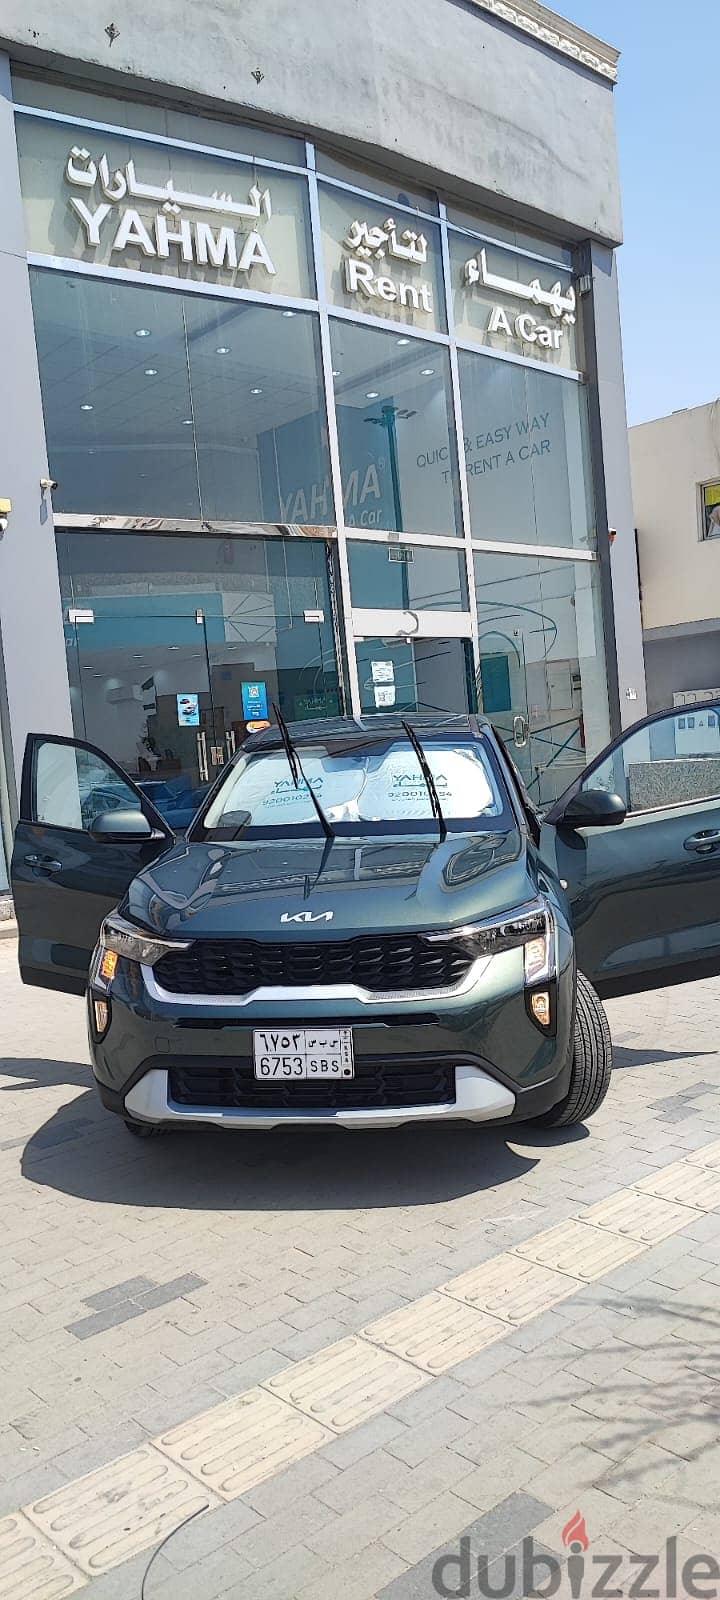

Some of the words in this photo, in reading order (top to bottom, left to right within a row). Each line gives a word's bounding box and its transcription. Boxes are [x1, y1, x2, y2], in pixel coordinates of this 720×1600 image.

[65, 145, 273, 223] السيارات
[343, 217, 429, 265] لتأجير
[70, 196, 277, 275] YAHMA
[345, 258, 434, 313] Rent
[487, 306, 513, 337] A
[514, 313, 564, 350] Car
[464, 248, 577, 326] يهماء
[416, 446, 449, 468] QUIC
[476, 424, 512, 450] EASY
[516, 412, 550, 436] WAY
[465, 454, 502, 476] RENT
[505, 450, 515, 466] A
[518, 439, 551, 461] CAR
[280, 911, 333, 922] KIA
[259, 1033, 301, 1052] ٦٧٥٣
[260, 1057, 303, 1076] 6753
[310, 1060, 339, 1073] SBS
